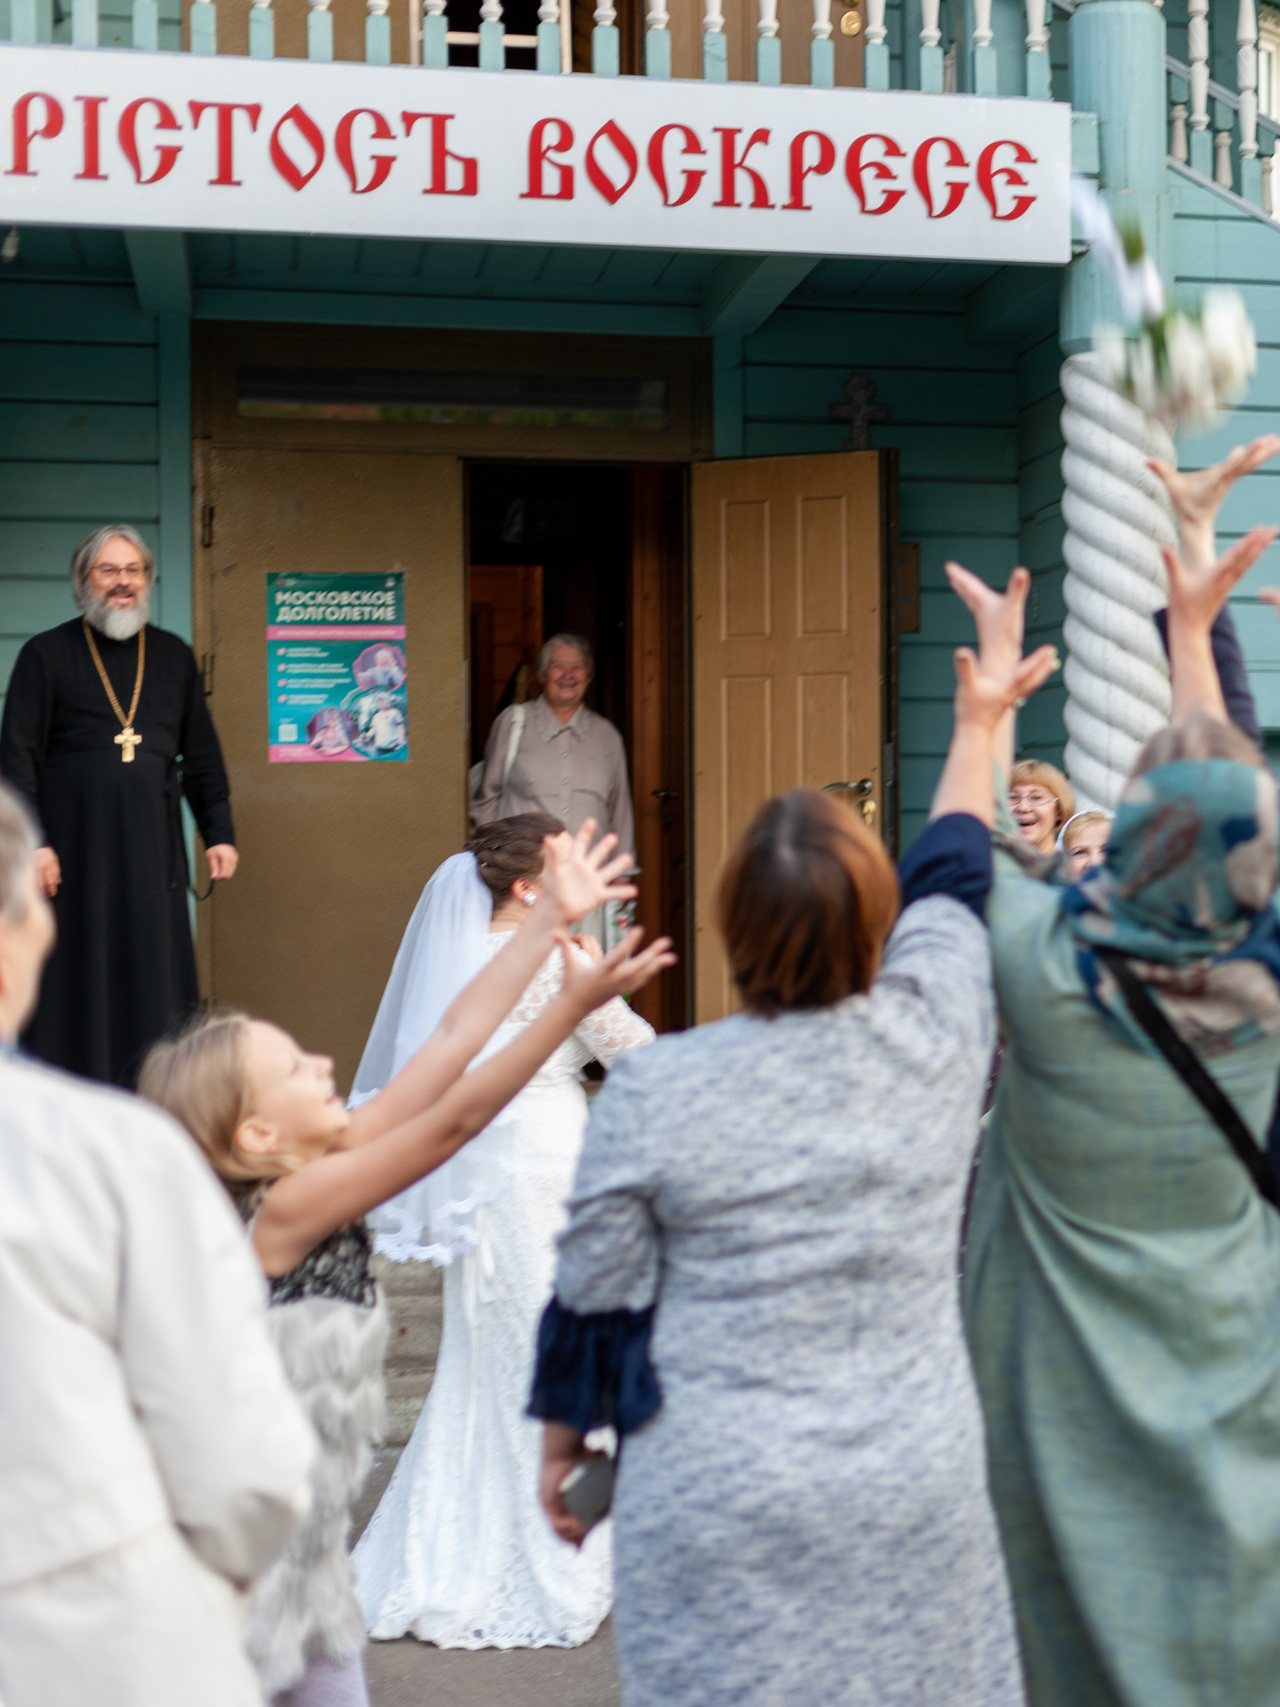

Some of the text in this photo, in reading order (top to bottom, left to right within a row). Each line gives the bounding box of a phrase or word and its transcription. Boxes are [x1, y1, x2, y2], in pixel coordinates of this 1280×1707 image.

[519, 117, 1038, 221] ВОСКРЕСЕ
[275, 591, 396, 605] МОСКОВСКОЕ
[276, 606, 396, 622] ДОЛГОЛЕТИЕ
